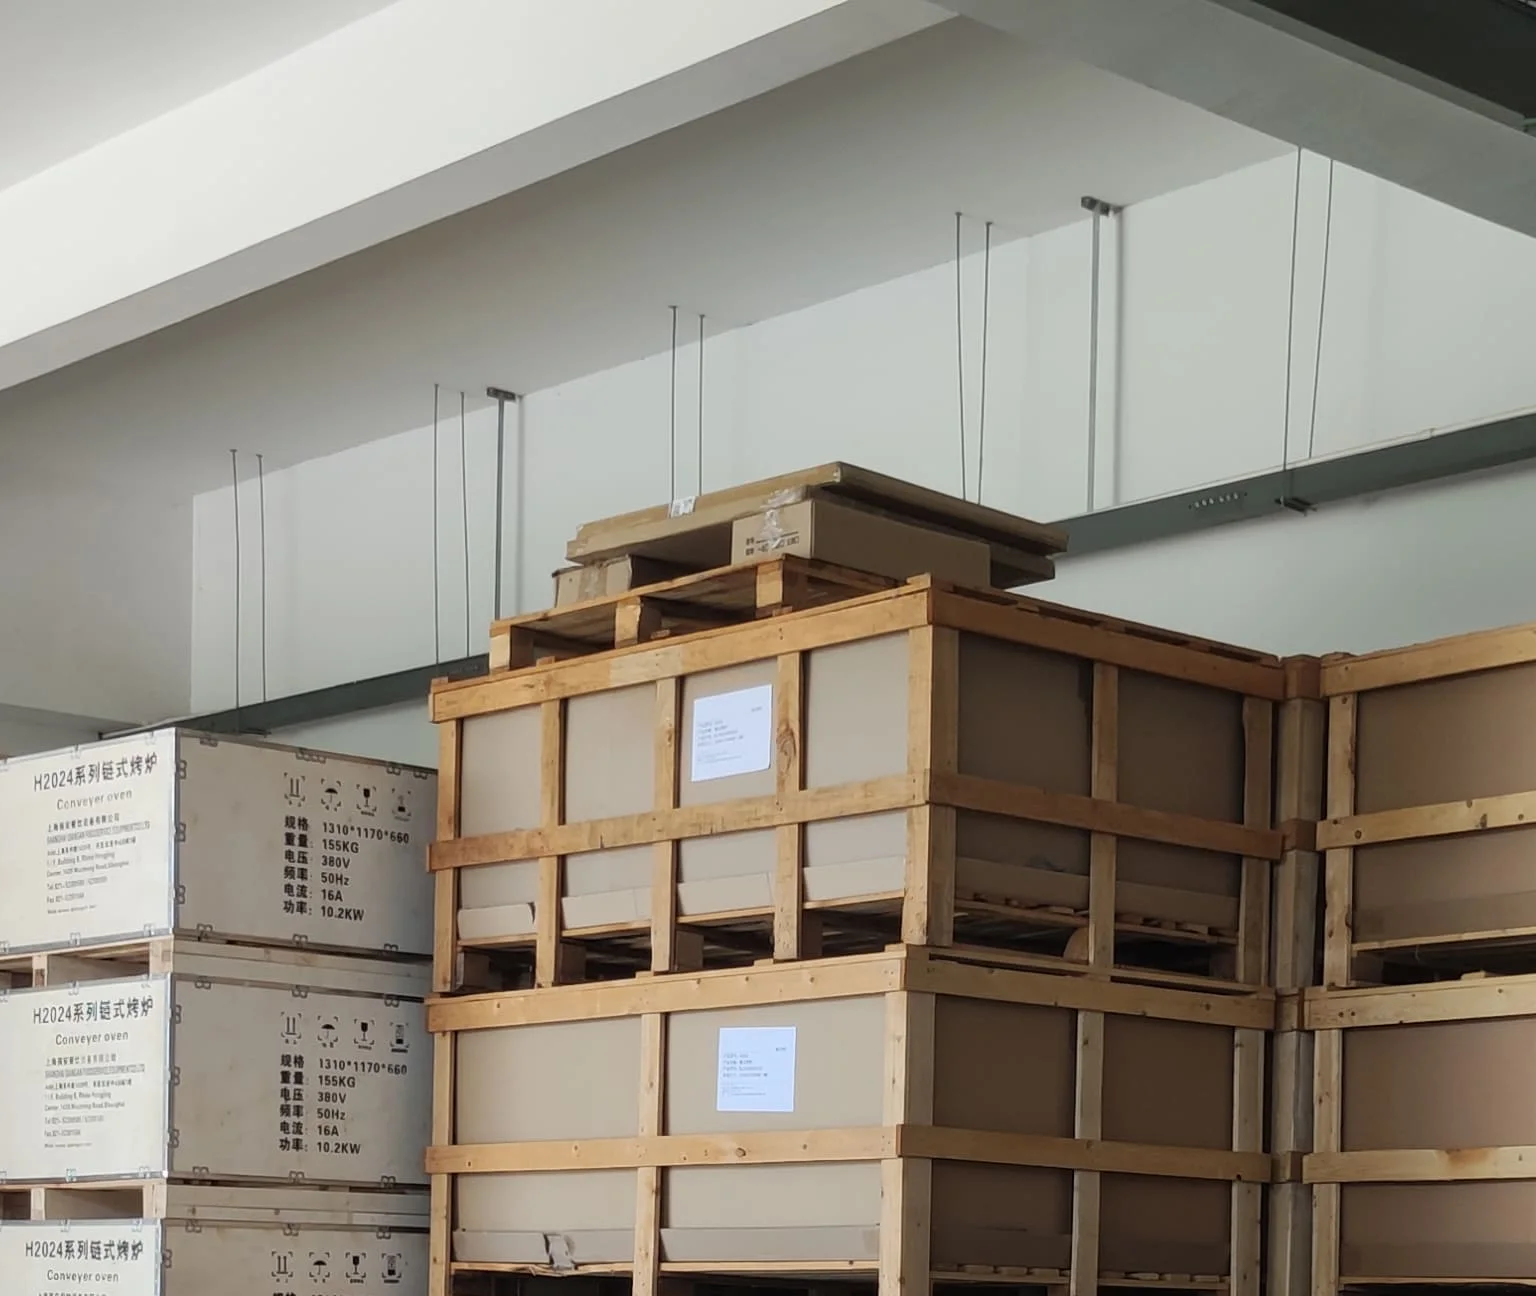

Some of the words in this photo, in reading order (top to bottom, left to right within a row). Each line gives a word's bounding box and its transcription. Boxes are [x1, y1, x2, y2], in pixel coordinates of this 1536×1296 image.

[33, 753, 158, 793] H2024系列链式烤炉
[56, 792, 105, 811] Conveyer
[106, 788, 132, 802] oven
[322, 838, 359, 853] 155KG
[321, 855, 350, 869] 380V
[321, 872, 349, 886] 50Hz
[321, 888, 343, 902] 16A
[321, 905, 364, 921] 10.2KW
[33, 996, 153, 1024] H2024系列链式烤炉
[55, 1031, 103, 1048] Conveyer
[105, 1029, 128, 1043] oven
[318, 1075, 355, 1088] 155KG
[318, 1091, 346, 1104] 380V
[317, 1108, 345, 1120] 50Hz
[317, 1125, 339, 1136] 16A
[317, 1142, 360, 1154] 10.2KW
[25, 1239, 144, 1261] H2024系列链式烤炉
[46, 1269, 93, 1284] Conveyer
[95, 1271, 119, 1282] oven
